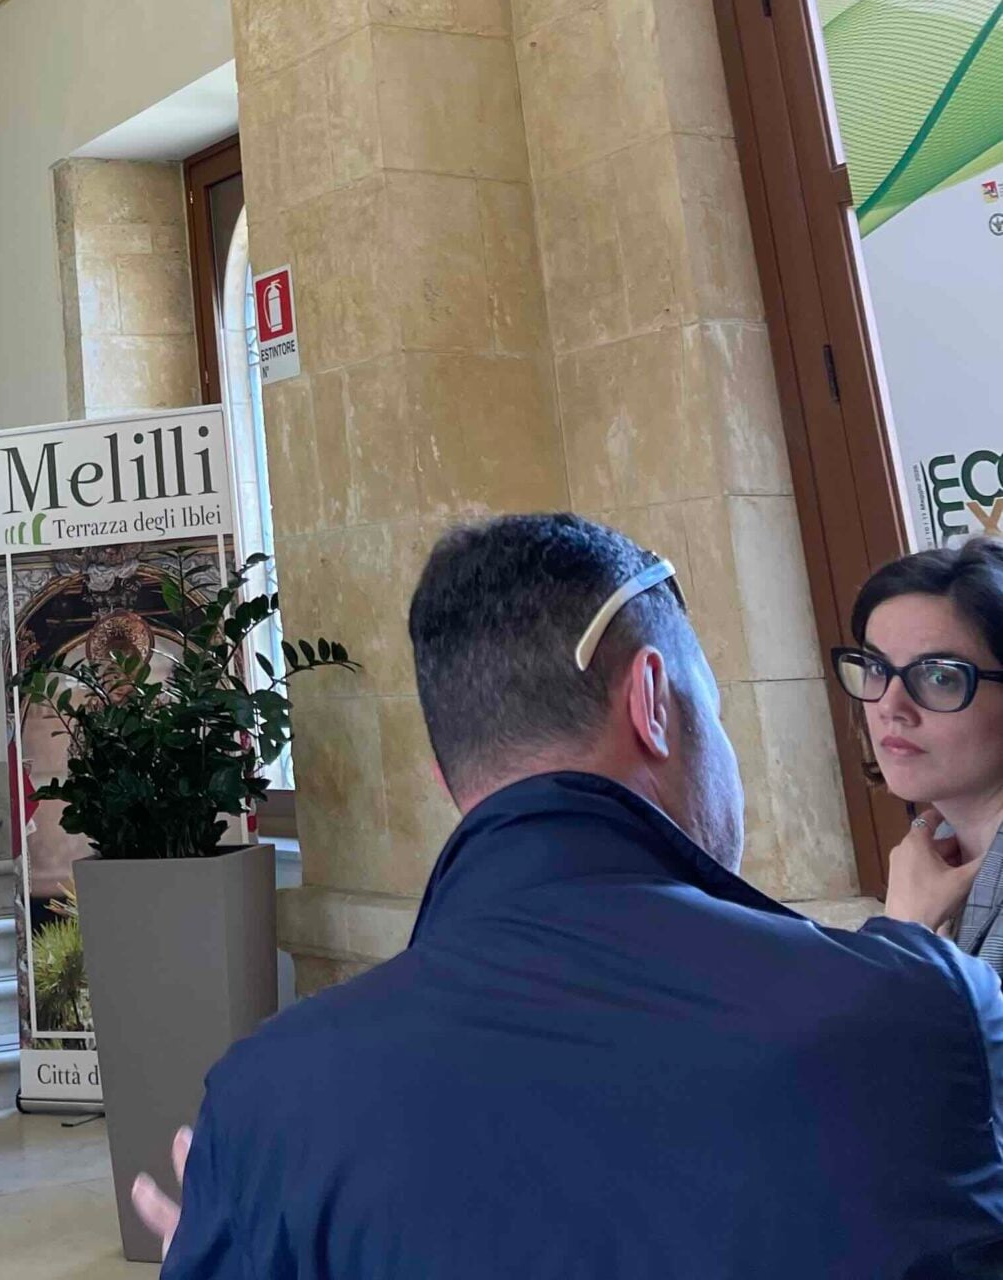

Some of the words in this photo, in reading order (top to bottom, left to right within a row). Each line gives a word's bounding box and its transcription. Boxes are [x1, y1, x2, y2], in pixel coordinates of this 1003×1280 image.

[260, 339, 296, 362] ESTINTORE
[0, 425, 219, 515] Melilli
[52, 517, 129, 540] Terrazza
[133, 509, 176, 536] degli
[182, 504, 223, 528] Iblei
[37, 1063, 81, 1085] Città
[88, 1064, 100, 1086] d
